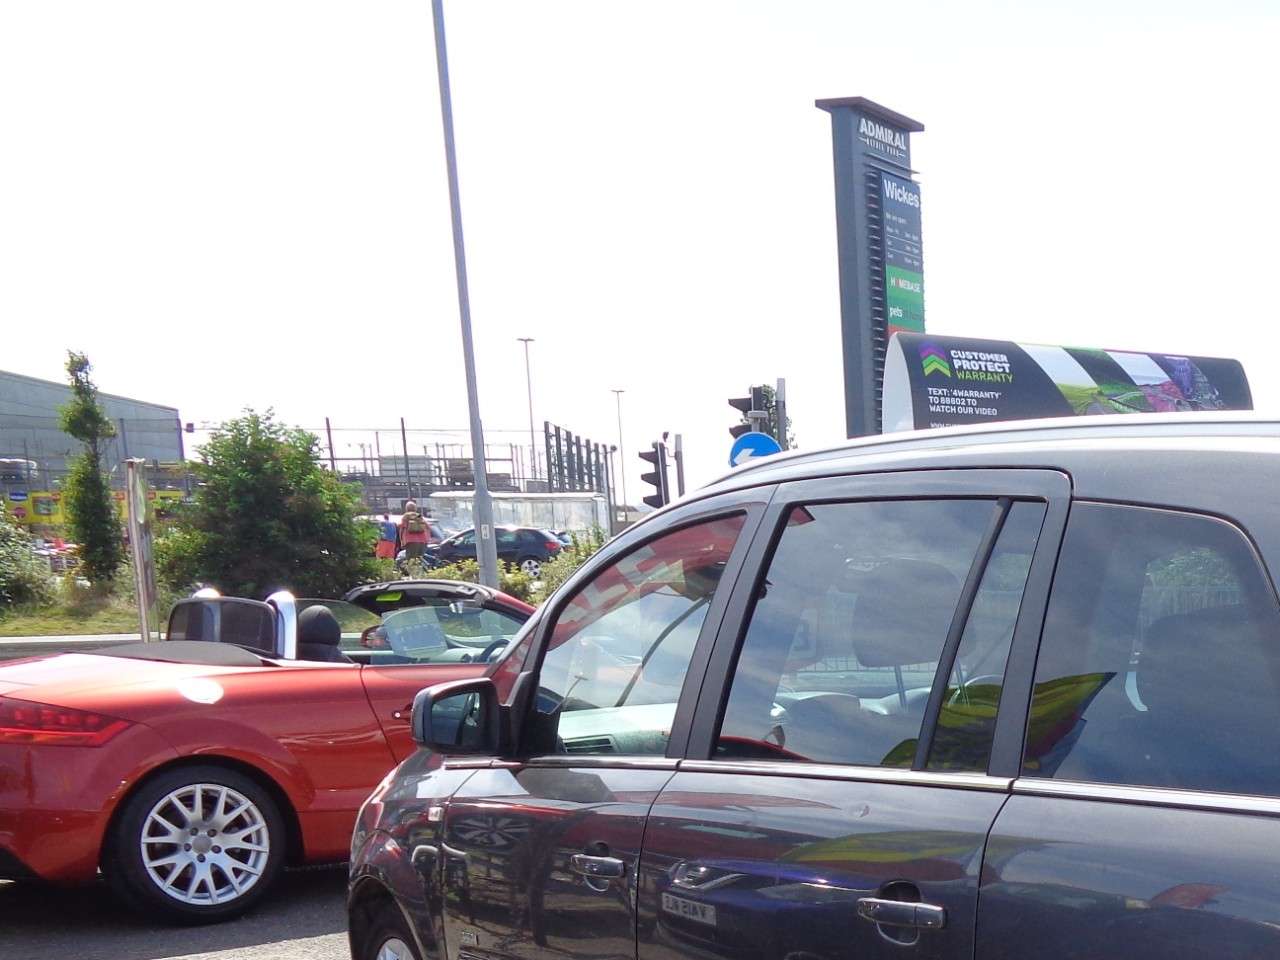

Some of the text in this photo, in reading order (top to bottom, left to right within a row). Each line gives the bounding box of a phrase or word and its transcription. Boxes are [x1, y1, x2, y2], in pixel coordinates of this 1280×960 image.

[859, 117, 907, 151] ADMIRAL
[883, 178, 920, 209] Wickes
[950, 350, 1008, 363] CUSTOMER
[952, 359, 1010, 373] PROTECT
[956, 370, 1014, 383] WARRANTY
[927, 387, 950, 397] TEXT:
[928, 396, 939, 404] TO
[966, 398, 977, 407] TO
[929, 404, 998, 416] WATCH OUR VIDEO
